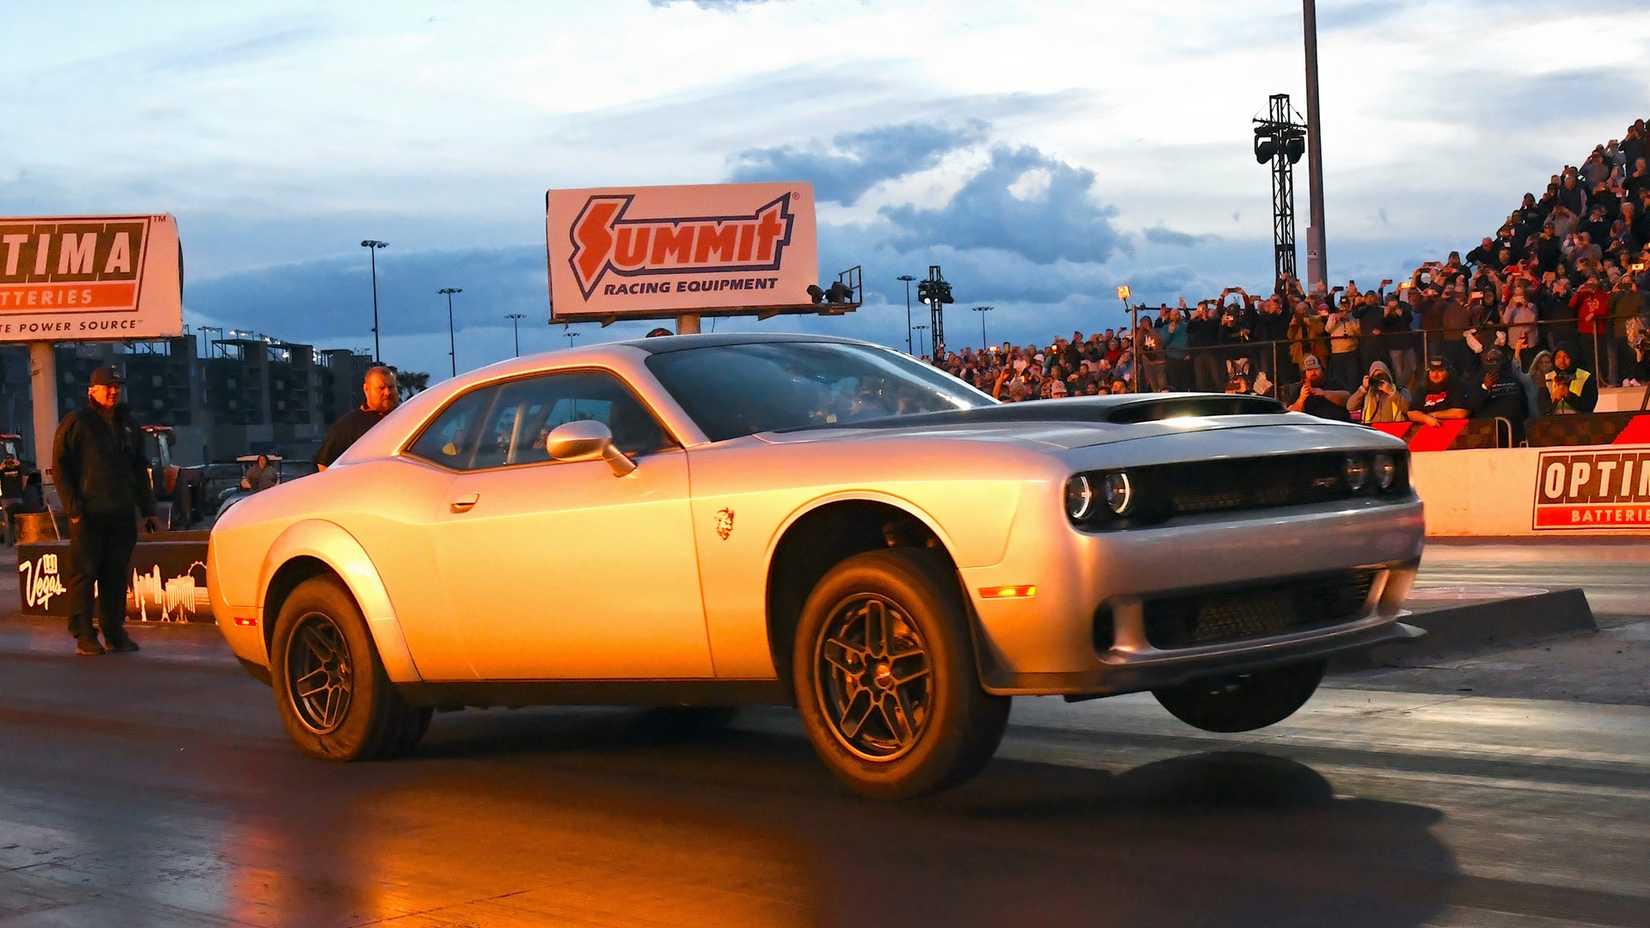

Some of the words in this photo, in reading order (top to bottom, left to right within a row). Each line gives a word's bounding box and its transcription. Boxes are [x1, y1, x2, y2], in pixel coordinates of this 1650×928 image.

[3, 232, 131, 275] TIMA
[604, 282, 671, 295] RACING
[676, 278, 778, 292] EQUIPMENT
[19, 322, 71, 332] POWER
[79, 319, 136, 331] SOURCE
[19, 557, 67, 610] Vegas
